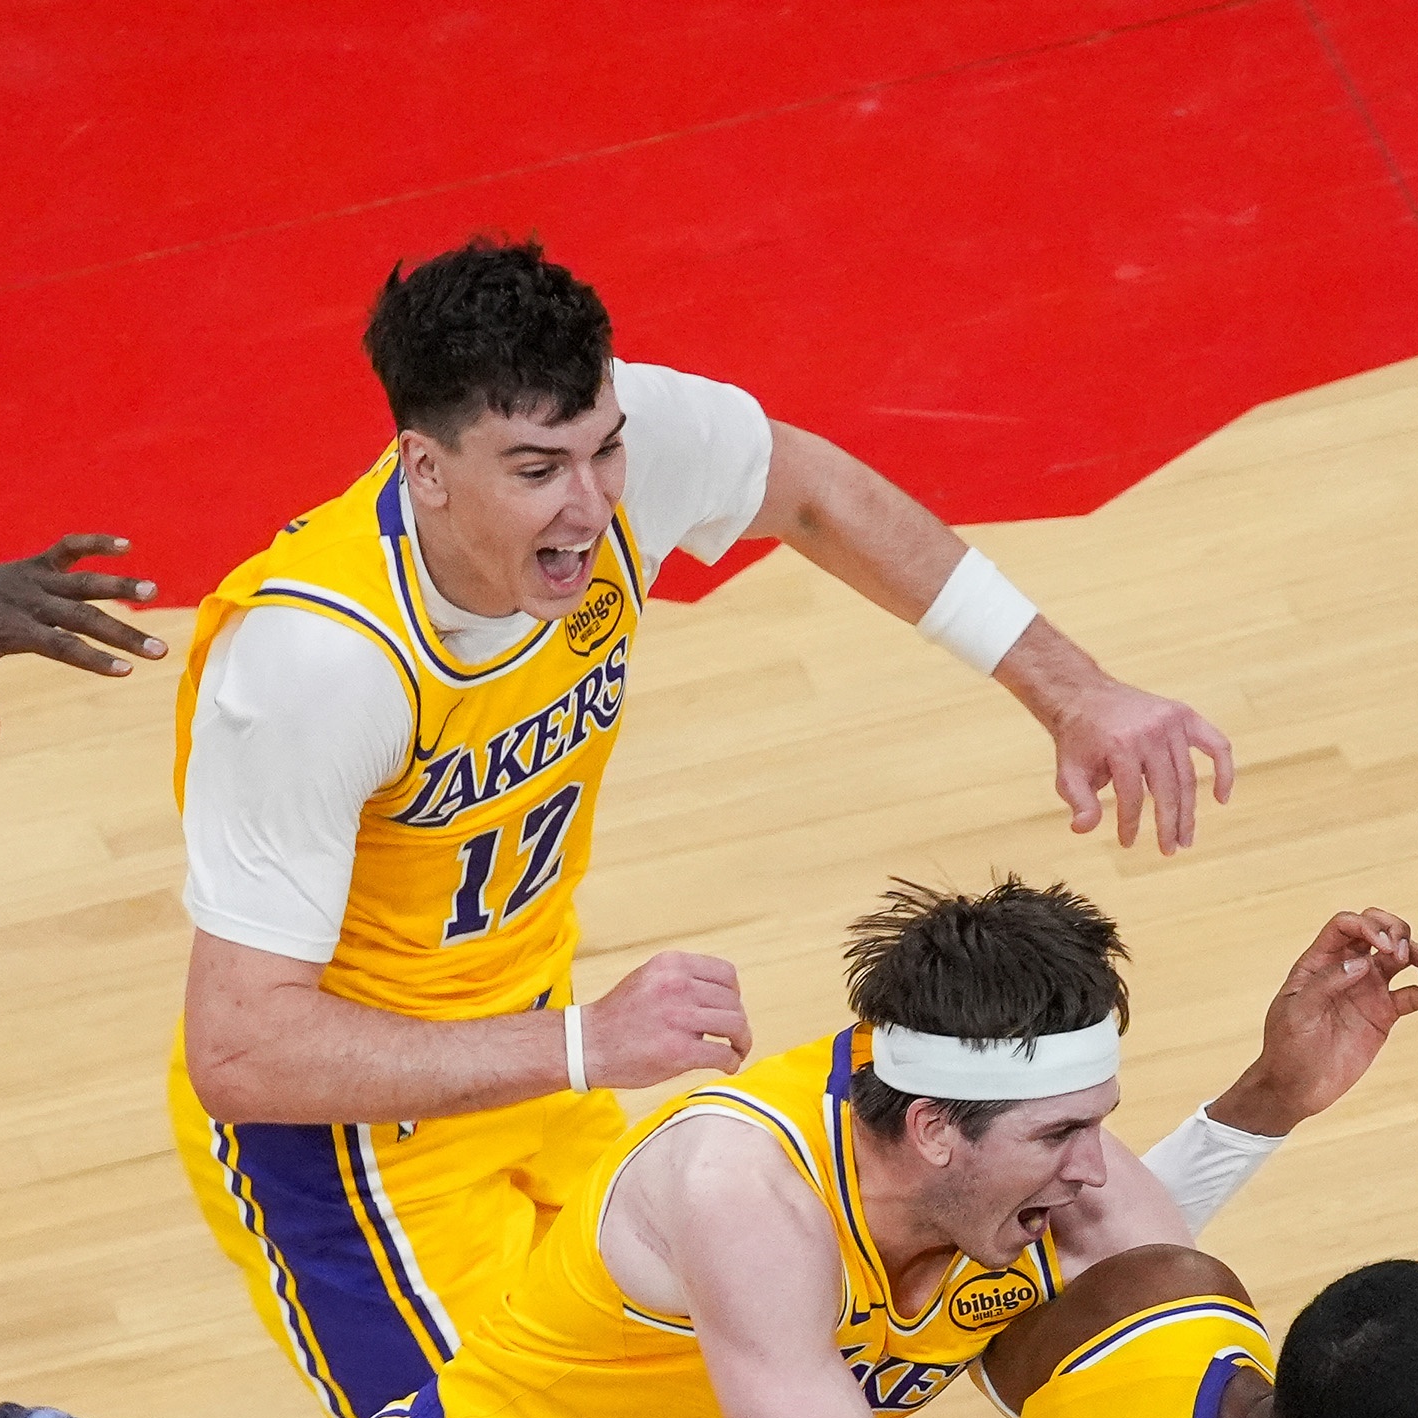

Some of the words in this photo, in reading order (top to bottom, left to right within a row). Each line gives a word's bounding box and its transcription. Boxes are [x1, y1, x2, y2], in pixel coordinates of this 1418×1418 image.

[567, 591, 618, 640] bibigo
[389, 634, 628, 827] LAKERS
[440, 782, 583, 949] 12
[956, 1287, 1032, 1316] bibigo
[972, 1308, 1004, 1321] 비비고
